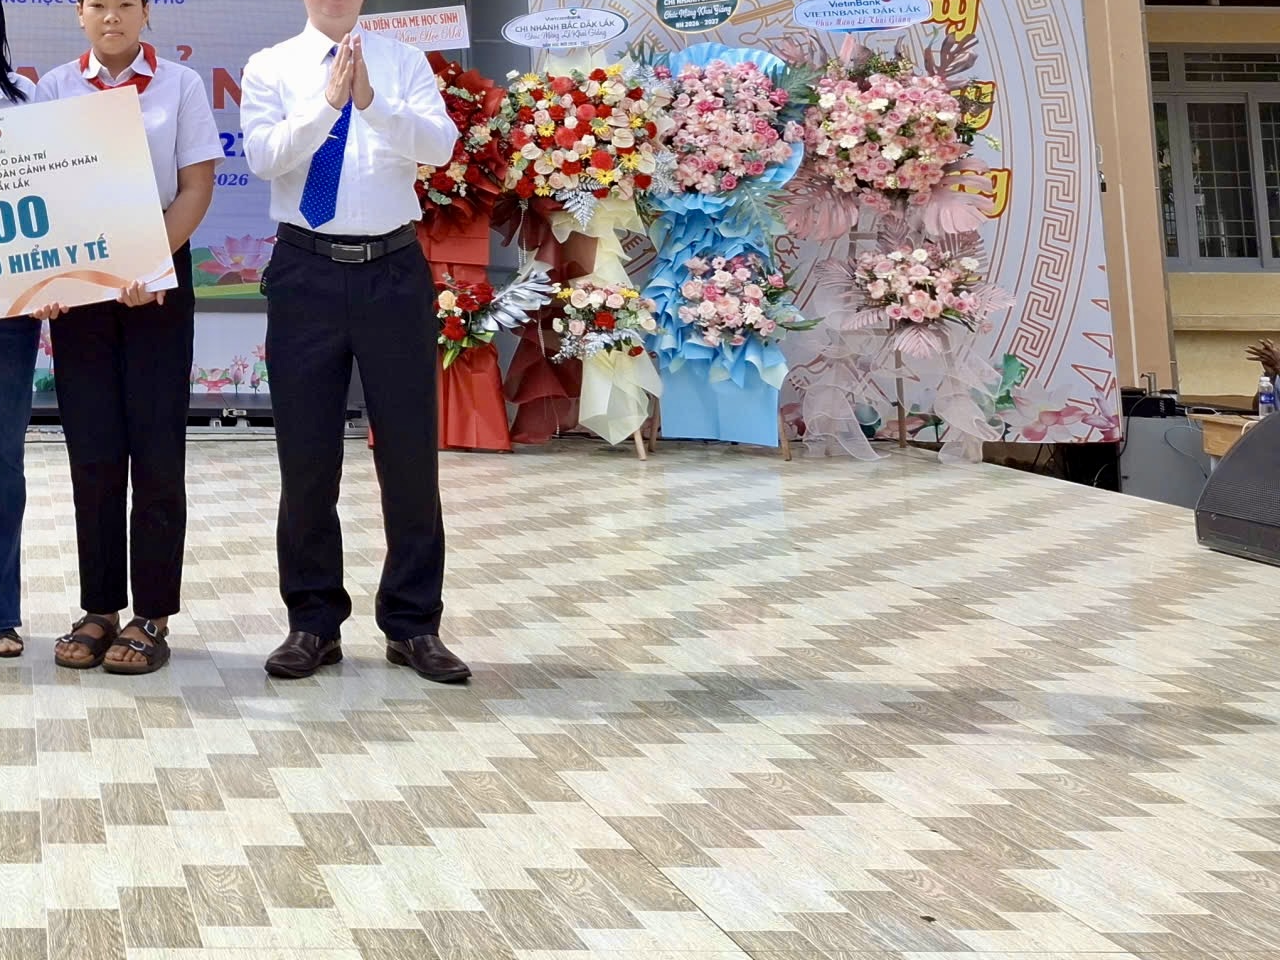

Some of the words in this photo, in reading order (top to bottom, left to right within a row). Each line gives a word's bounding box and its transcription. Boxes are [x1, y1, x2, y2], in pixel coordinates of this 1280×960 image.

[828, 0, 881, 8] VietinBank
[392, 17, 407, 29] CHA
[421, 14, 438, 29] HỌC
[439, 12, 459, 24] SINH
[803, 7, 869, 18] VIETINBANK
[530, 22, 559, 32] NHÁNH
[11, 152, 32, 166] DÂN
[33, 150, 47, 162] TRÍ
[17, 163, 47, 177] CẢNH
[48, 158, 70, 172] KHÓ
[71, 154, 99, 168] KHĂN
[9, 245, 61, 274] HIỂM
[64, 245, 79, 265] Y
[84, 233, 109, 261] TẾ
